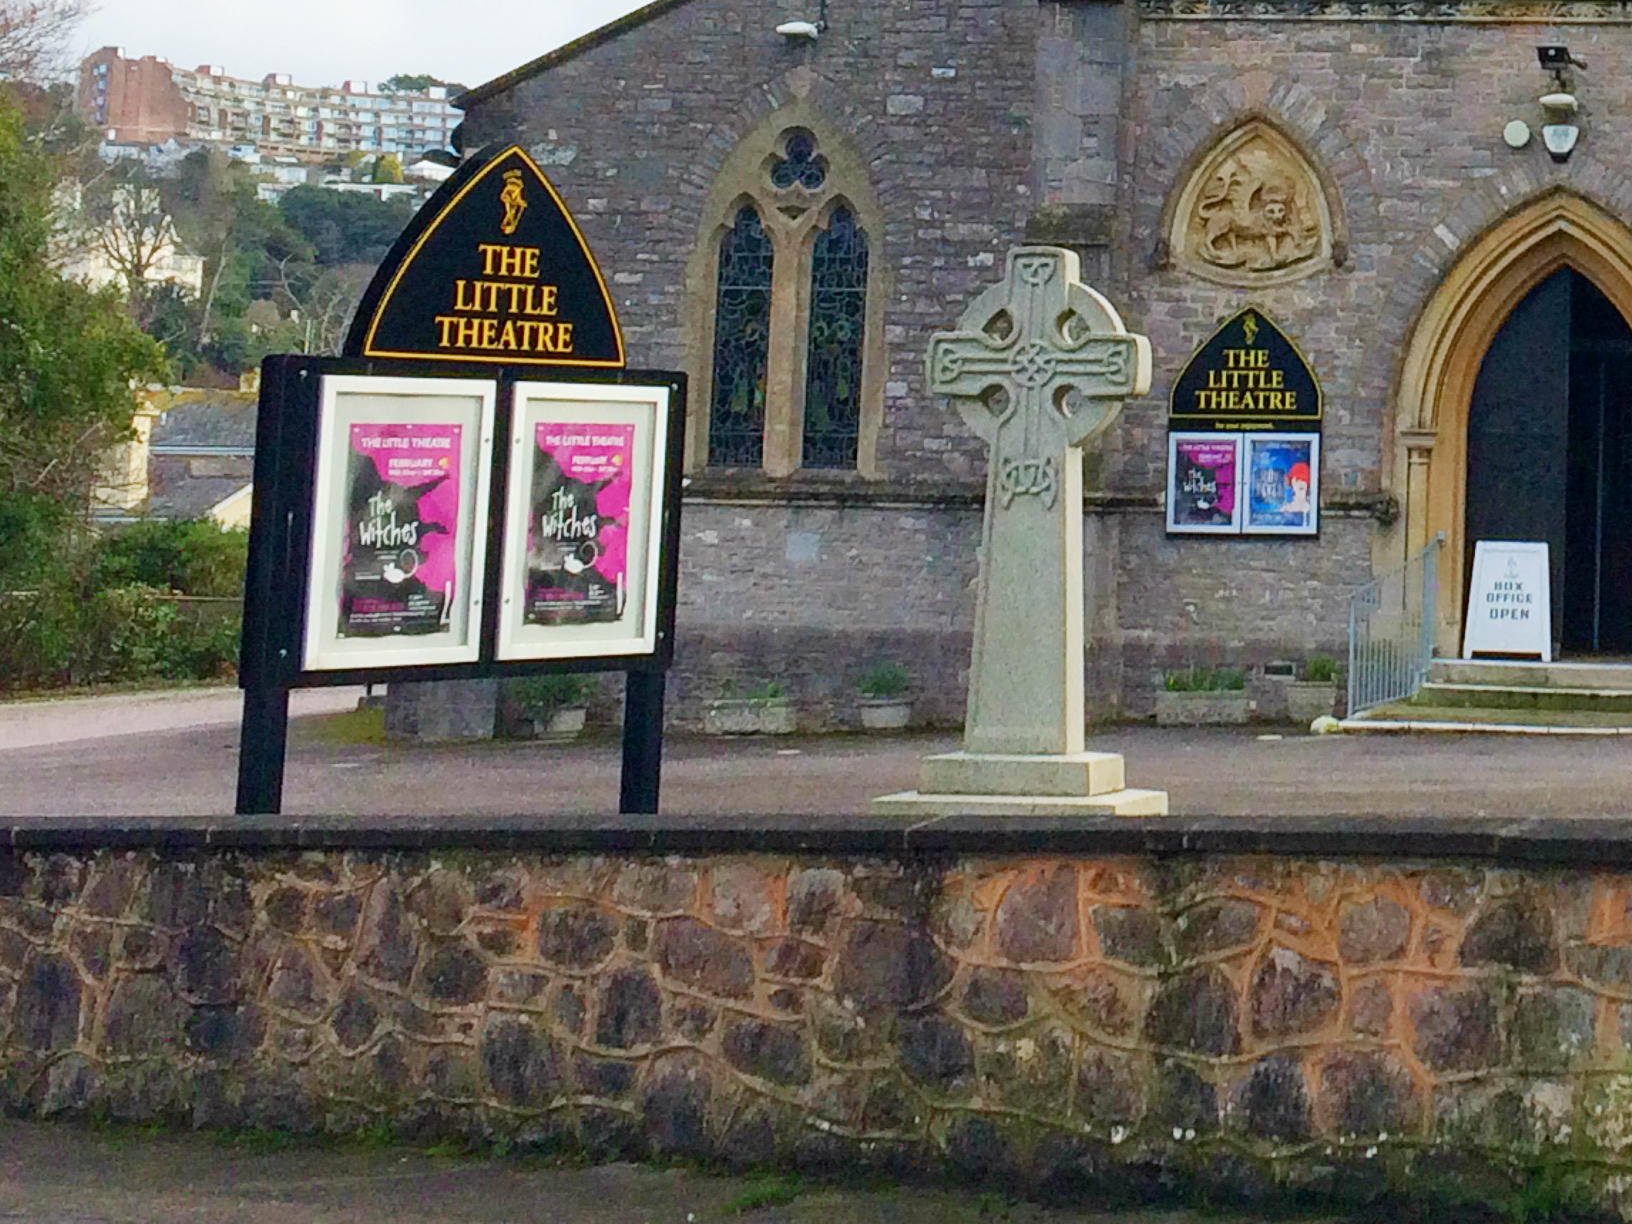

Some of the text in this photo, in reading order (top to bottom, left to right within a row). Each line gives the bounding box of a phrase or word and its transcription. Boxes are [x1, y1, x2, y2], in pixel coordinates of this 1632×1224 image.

[478, 244, 541, 278] THE
[454, 279, 559, 317] LITTLE
[435, 316, 574, 353] THEATRE
[1223, 349, 1270, 368] THE
[1207, 370, 1285, 389] LITTLE
[1195, 391, 1297, 409] THEATRE
[361, 437, 452, 449] THE LITTLE THEATRE
[367, 490, 393, 517] The
[551, 486, 575, 511] The
[359, 510, 420, 549] Witches
[542, 505, 598, 541] Witches
[1485, 592, 1533, 604] OFFICE
[1488, 607, 1530, 620] OPEN
